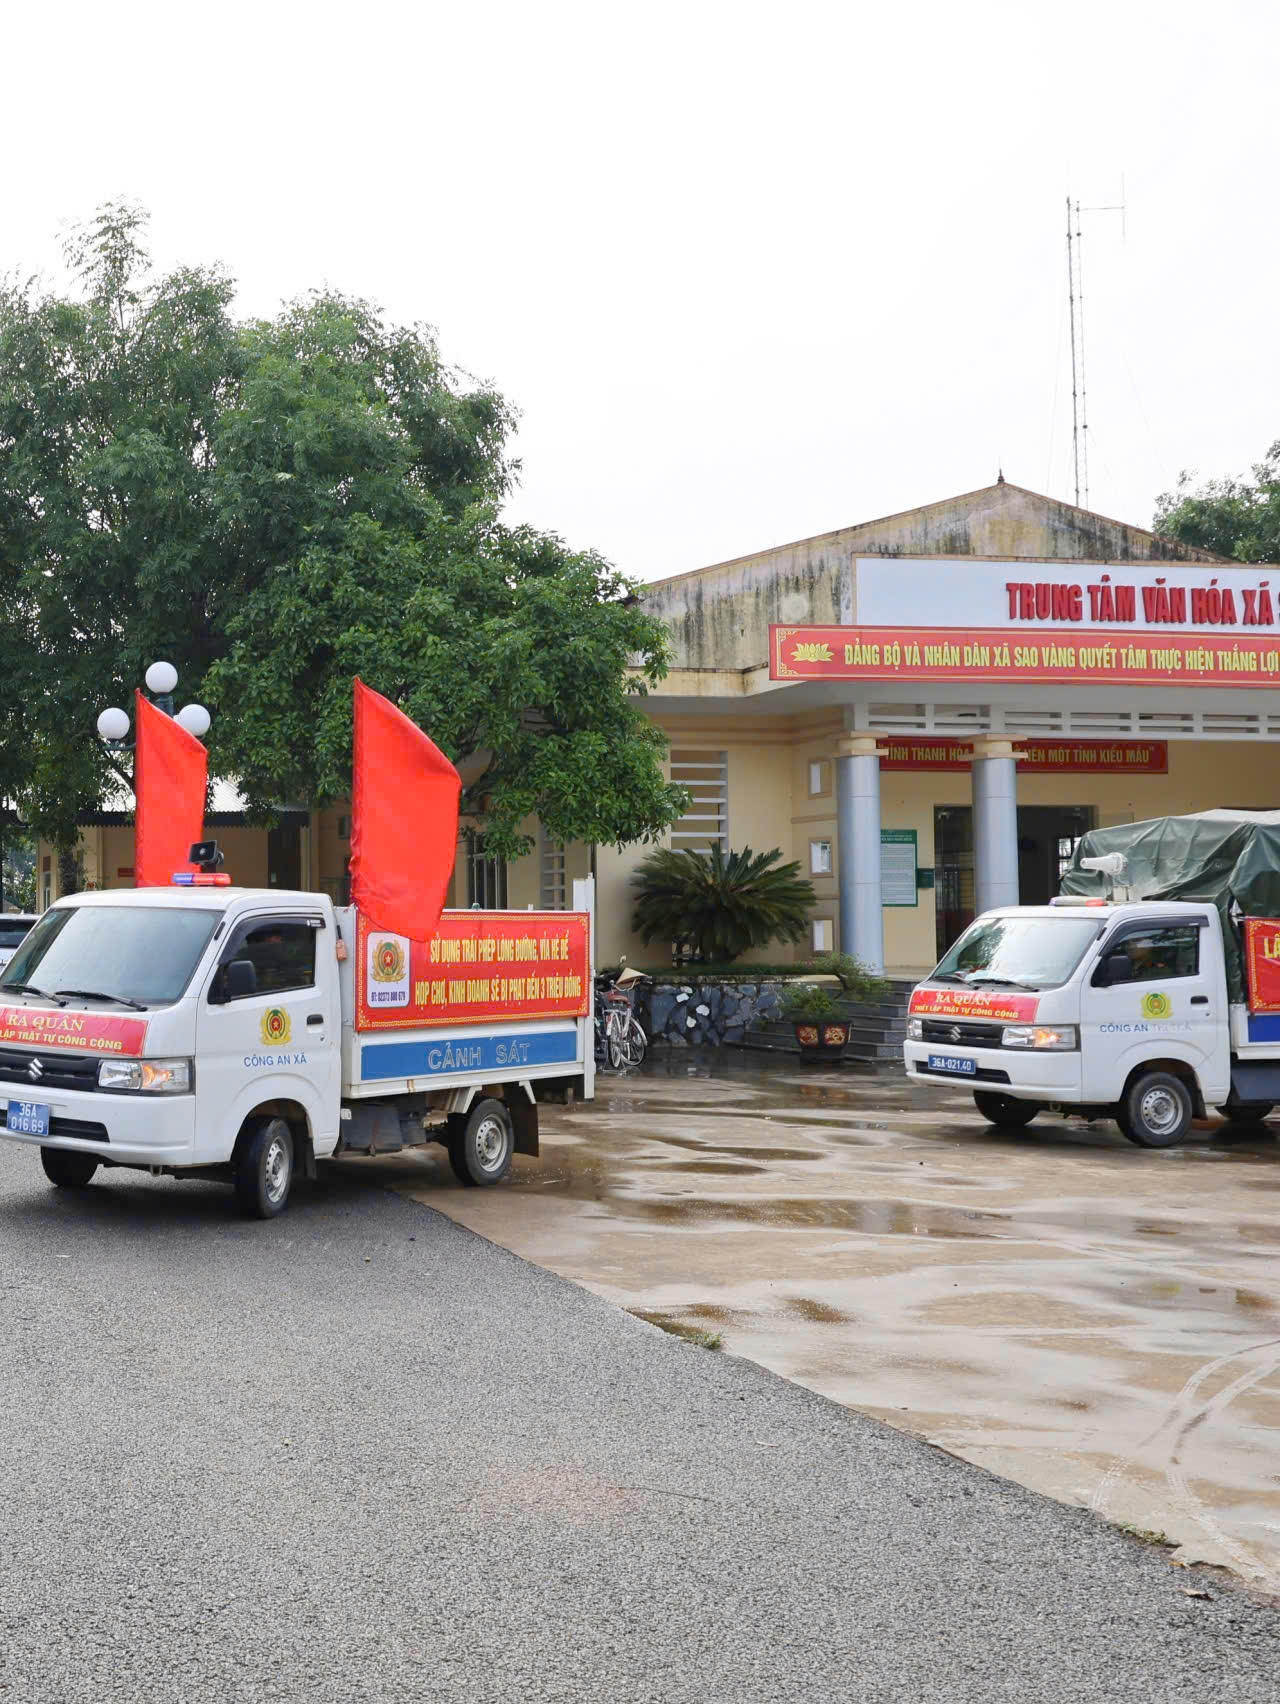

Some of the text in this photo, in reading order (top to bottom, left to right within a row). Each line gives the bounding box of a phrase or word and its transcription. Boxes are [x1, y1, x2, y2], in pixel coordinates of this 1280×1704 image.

[1006, 582, 1083, 622] TRUNG
[1087, 574, 1137, 622] TÂM
[1141, 577, 1187, 624] VĂN
[1190, 578, 1237, 625] HÓA
[844, 637, 880, 666] ĐẢNG
[883, 640, 901, 671] BỘ
[904, 640, 921, 666] VÀ
[924, 641, 961, 667] NHÂN
[963, 641, 990, 667] DÂN
[993, 642, 1011, 667] XÃ
[1014, 646, 1038, 668] SAO
[1041, 642, 1076, 668] VÀNG
[1079, 641, 1117, 670] QUYẾT
[1120, 644, 1147, 669] TÂM
[1150, 648, 1182, 675] THỰC
[1185, 645, 1214, 676] HIỆN
[1217, 643, 1257, 672] THẮNG
[912, 747, 946, 761] THANH
[448, 980, 466, 1004] KINH
[466, 979, 489, 1003] DOANH
[540, 977, 545, 999] 3
[936, 993, 951, 1003] RA
[7, 1014, 87, 1032] RA QUÂN
[1100, 1022, 1131, 1033] CÔNG
[1133, 1024, 1148, 1032] AN
[18, 1030, 41, 1042] TRẬT
[43, 1033, 57, 1043] TỰ
[57, 1034, 87, 1047] CÔNG
[89, 1037, 122, 1050] CỘNG
[243, 1052, 307, 1067] CÔNG AN XÃ
[428, 1040, 531, 1070] CẢNH SÁT
[932, 1057, 972, 1071] 36A-021.40
[19, 1103, 37, 1117] 36A
[11, 1116, 44, 1133] 016.69
